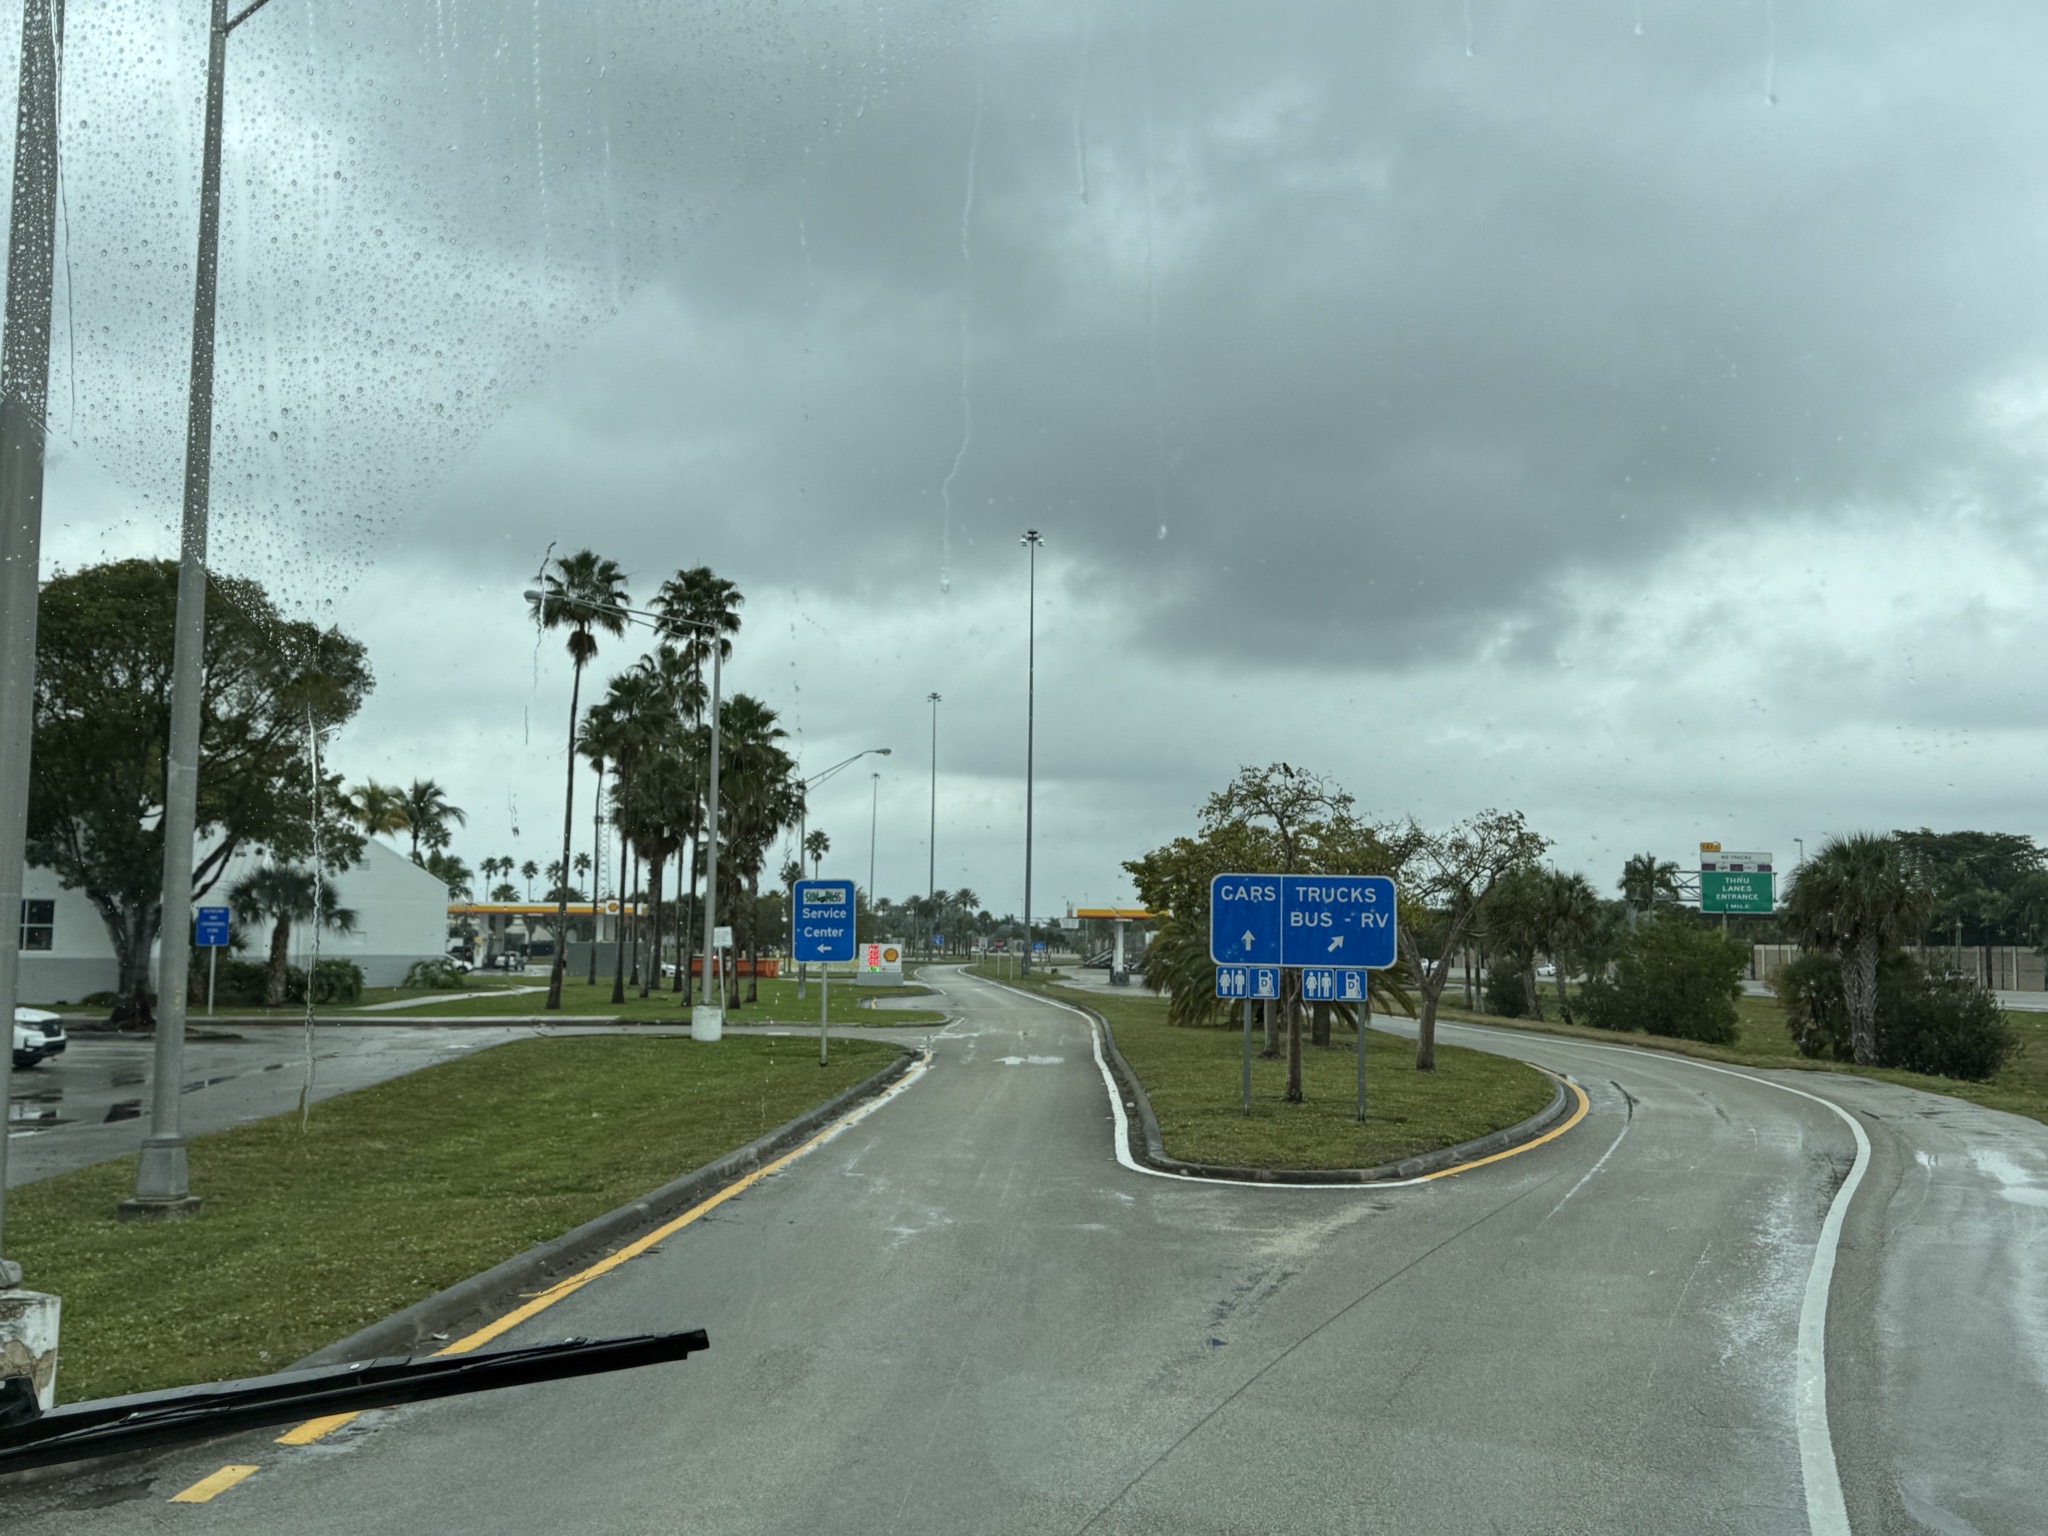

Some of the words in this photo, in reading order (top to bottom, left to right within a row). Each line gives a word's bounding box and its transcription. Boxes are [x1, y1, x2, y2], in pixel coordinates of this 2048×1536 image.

[1221, 886, 1276, 901] CARS
[1296, 887, 1376, 903] TRUCKS
[802, 908, 846, 919] Service
[1291, 911, 1332, 927] BUS
[1361, 912, 1389, 928] RV
[804, 927, 843, 938] Center
[1261, 979, 1268, 987] D
[1348, 981, 1355, 989] D
